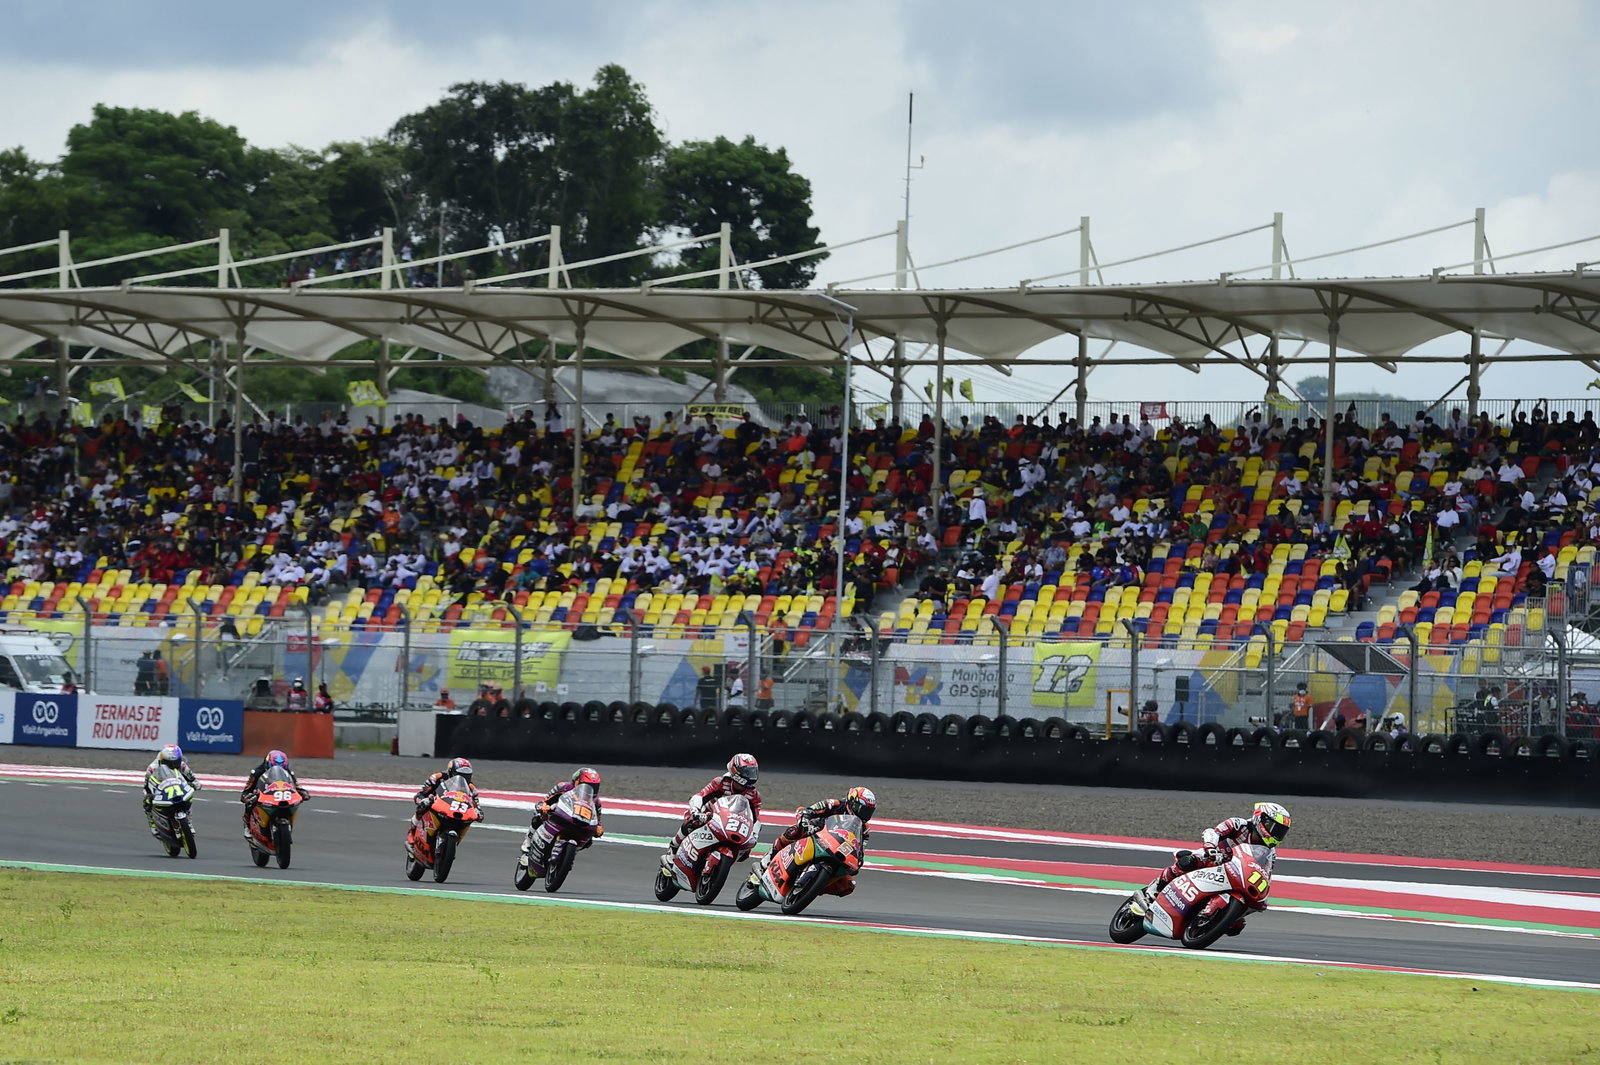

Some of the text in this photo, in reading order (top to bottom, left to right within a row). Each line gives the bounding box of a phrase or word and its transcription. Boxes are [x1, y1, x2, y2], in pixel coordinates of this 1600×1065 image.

[951, 668, 1015, 683] Mandala
[1033, 654, 1093, 694] 12
[949, 684, 1010, 699] GP Seri
[95, 704, 163, 722] TERMAS DE
[115, 723, 160, 741] HONDO
[164, 784, 184, 800] 71
[273, 790, 292, 801] 96
[449, 800, 469, 814] 53
[725, 818, 750, 838] 28
[769, 859, 785, 889] KTM
[1191, 870, 1225, 884] gaviota
[1247, 870, 1269, 893] 11
[1172, 873, 1199, 903] GAS
